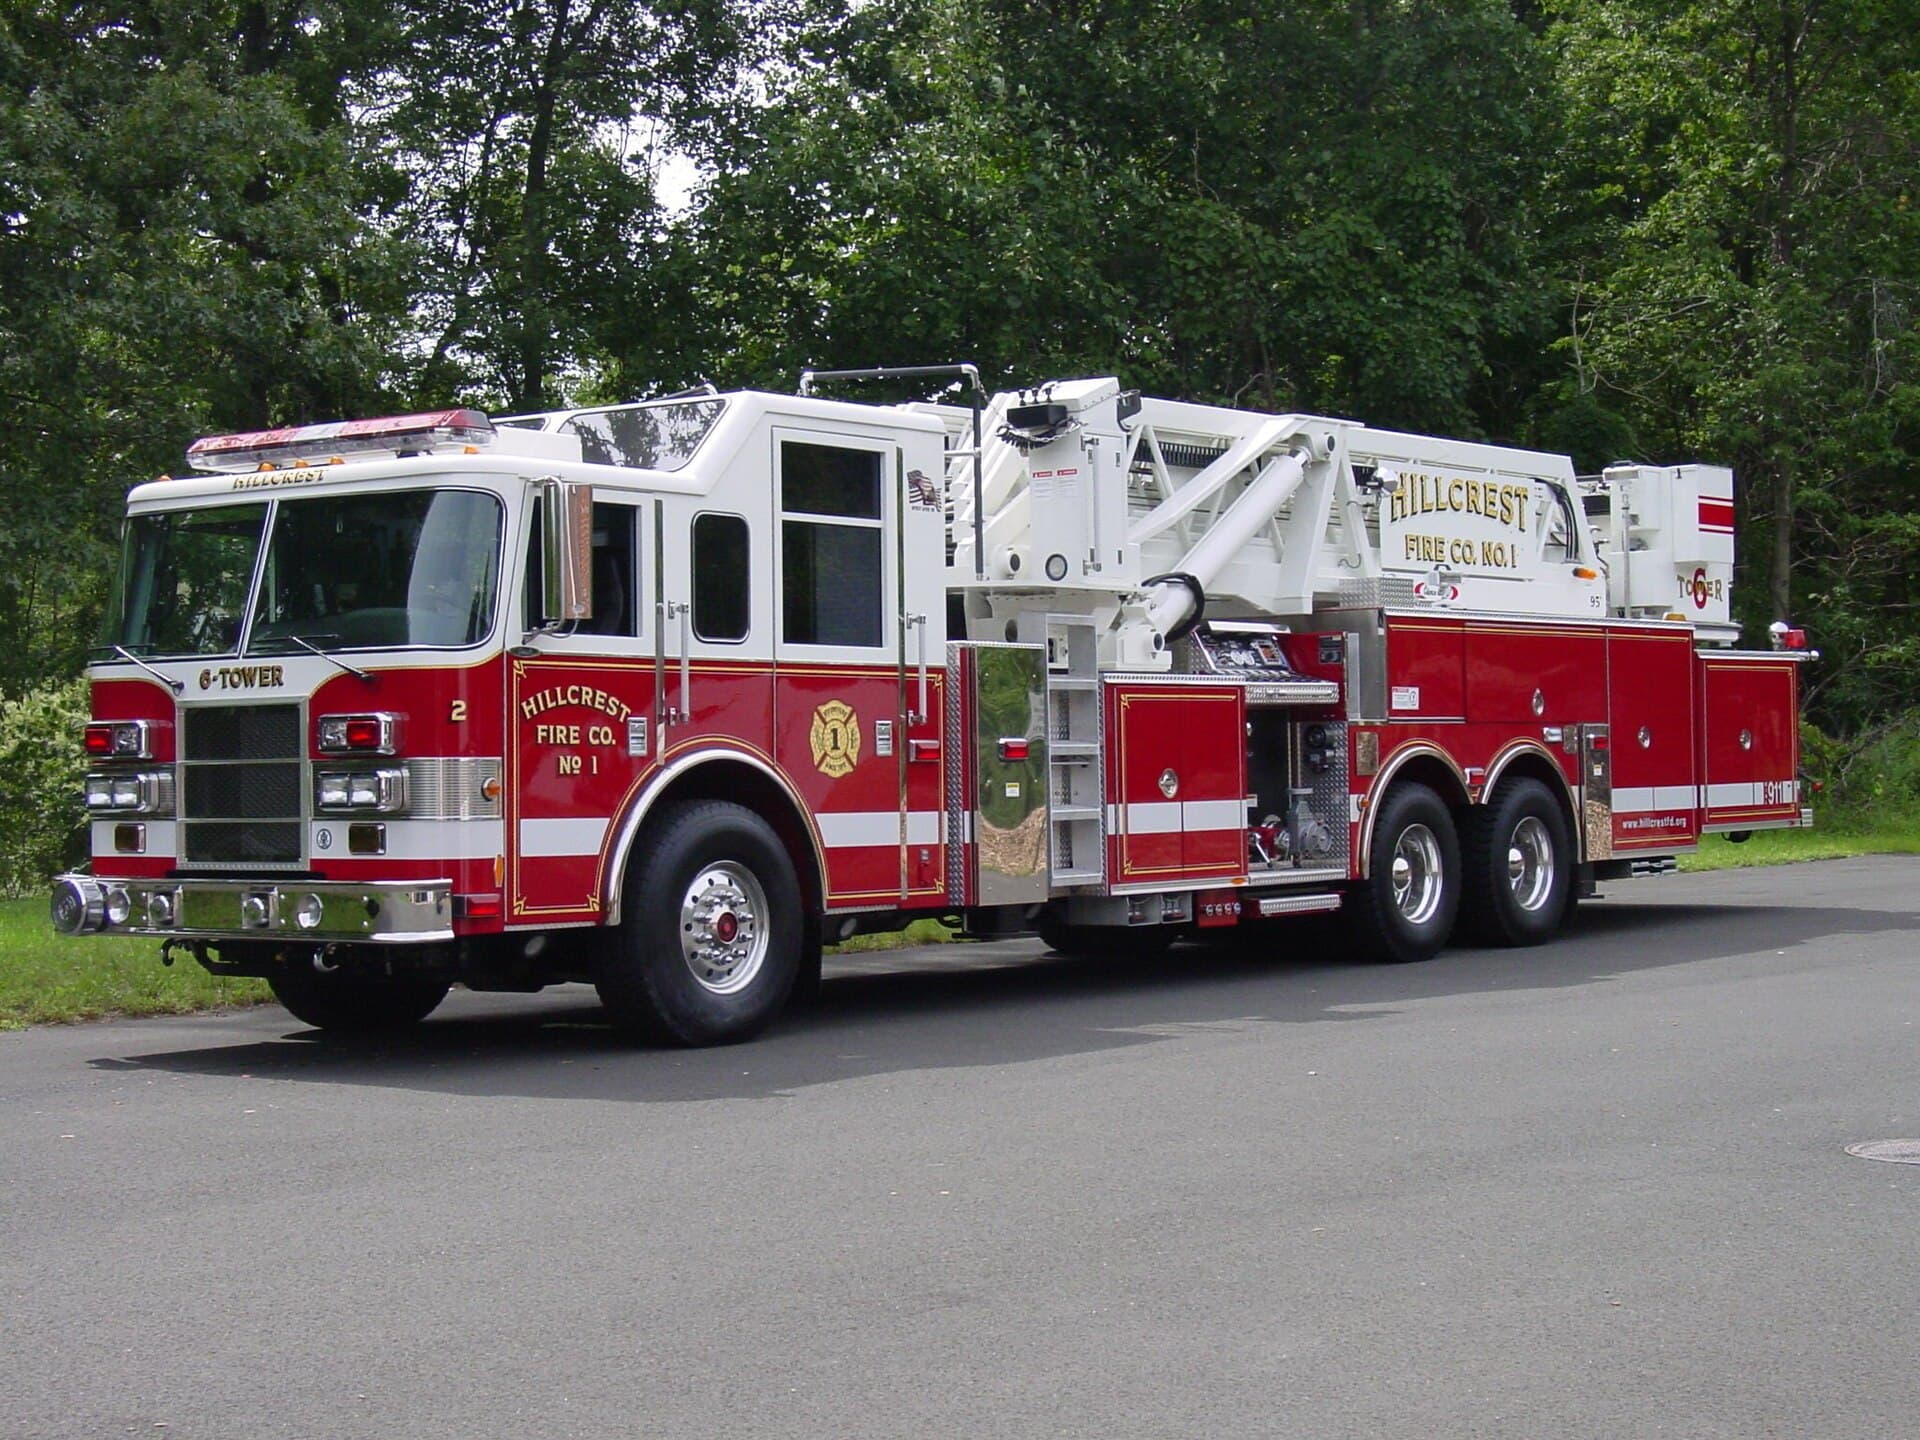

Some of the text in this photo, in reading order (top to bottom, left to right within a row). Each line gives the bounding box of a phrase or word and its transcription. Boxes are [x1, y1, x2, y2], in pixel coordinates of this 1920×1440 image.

[232, 469, 328, 489] HILLCREST
[1391, 472, 1528, 533] HILLCREST
[1405, 534, 1445, 562] FIRE
[1450, 538, 1477, 566] CO.
[199, 665, 284, 690] 6-TOWER
[451, 699, 467, 721] 2
[520, 685, 631, 723] HILLCREST
[536, 725, 616, 746] FIRE CO.
[831, 727, 841, 750] 1
[1767, 781, 1782, 805] 911
[1622, 816, 1687, 829] www.hillcrestfd.org
